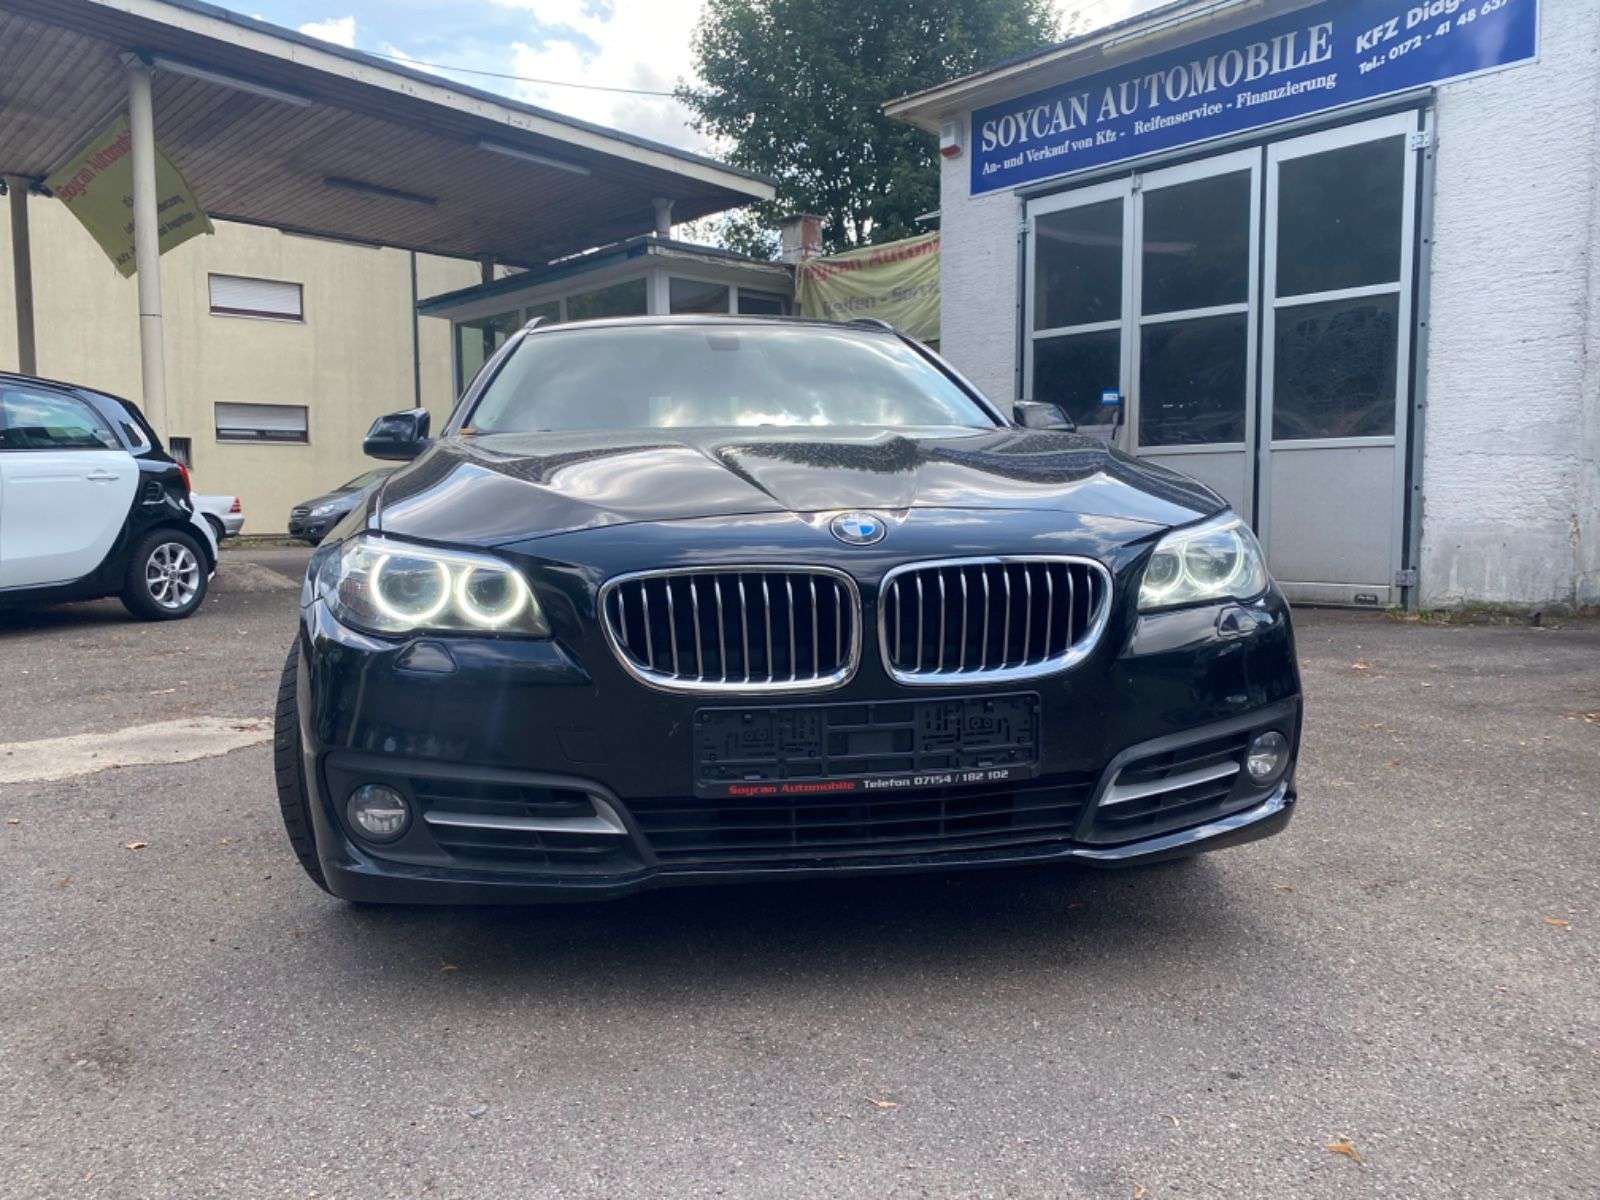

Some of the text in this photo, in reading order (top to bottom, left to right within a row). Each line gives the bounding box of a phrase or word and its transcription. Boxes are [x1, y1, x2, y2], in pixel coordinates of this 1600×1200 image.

[1356, 0, 1464, 54] KFZ Diag
[1388, 35, 1422, 60] 0172
[1435, 20, 1451, 36] 41
[1456, 8, 1477, 26] 48
[982, 21, 1333, 152] SOYCAN AUTOMOBILE
[1004, 153, 1024, 170] und
[1026, 140, 1070, 163] Verkauf
[1071, 136, 1093, 151] von
[1134, 101, 1224, 135] Reifenservice
[1236, 73, 1338, 109] Finanzierung
[728, 784, 777, 797] Soycan
[781, 780, 856, 794] Automobile
[864, 777, 911, 789] Telefon
[914, 774, 952, 786] 07154
[963, 771, 984, 782] 182
[988, 769, 1009, 780] 102
